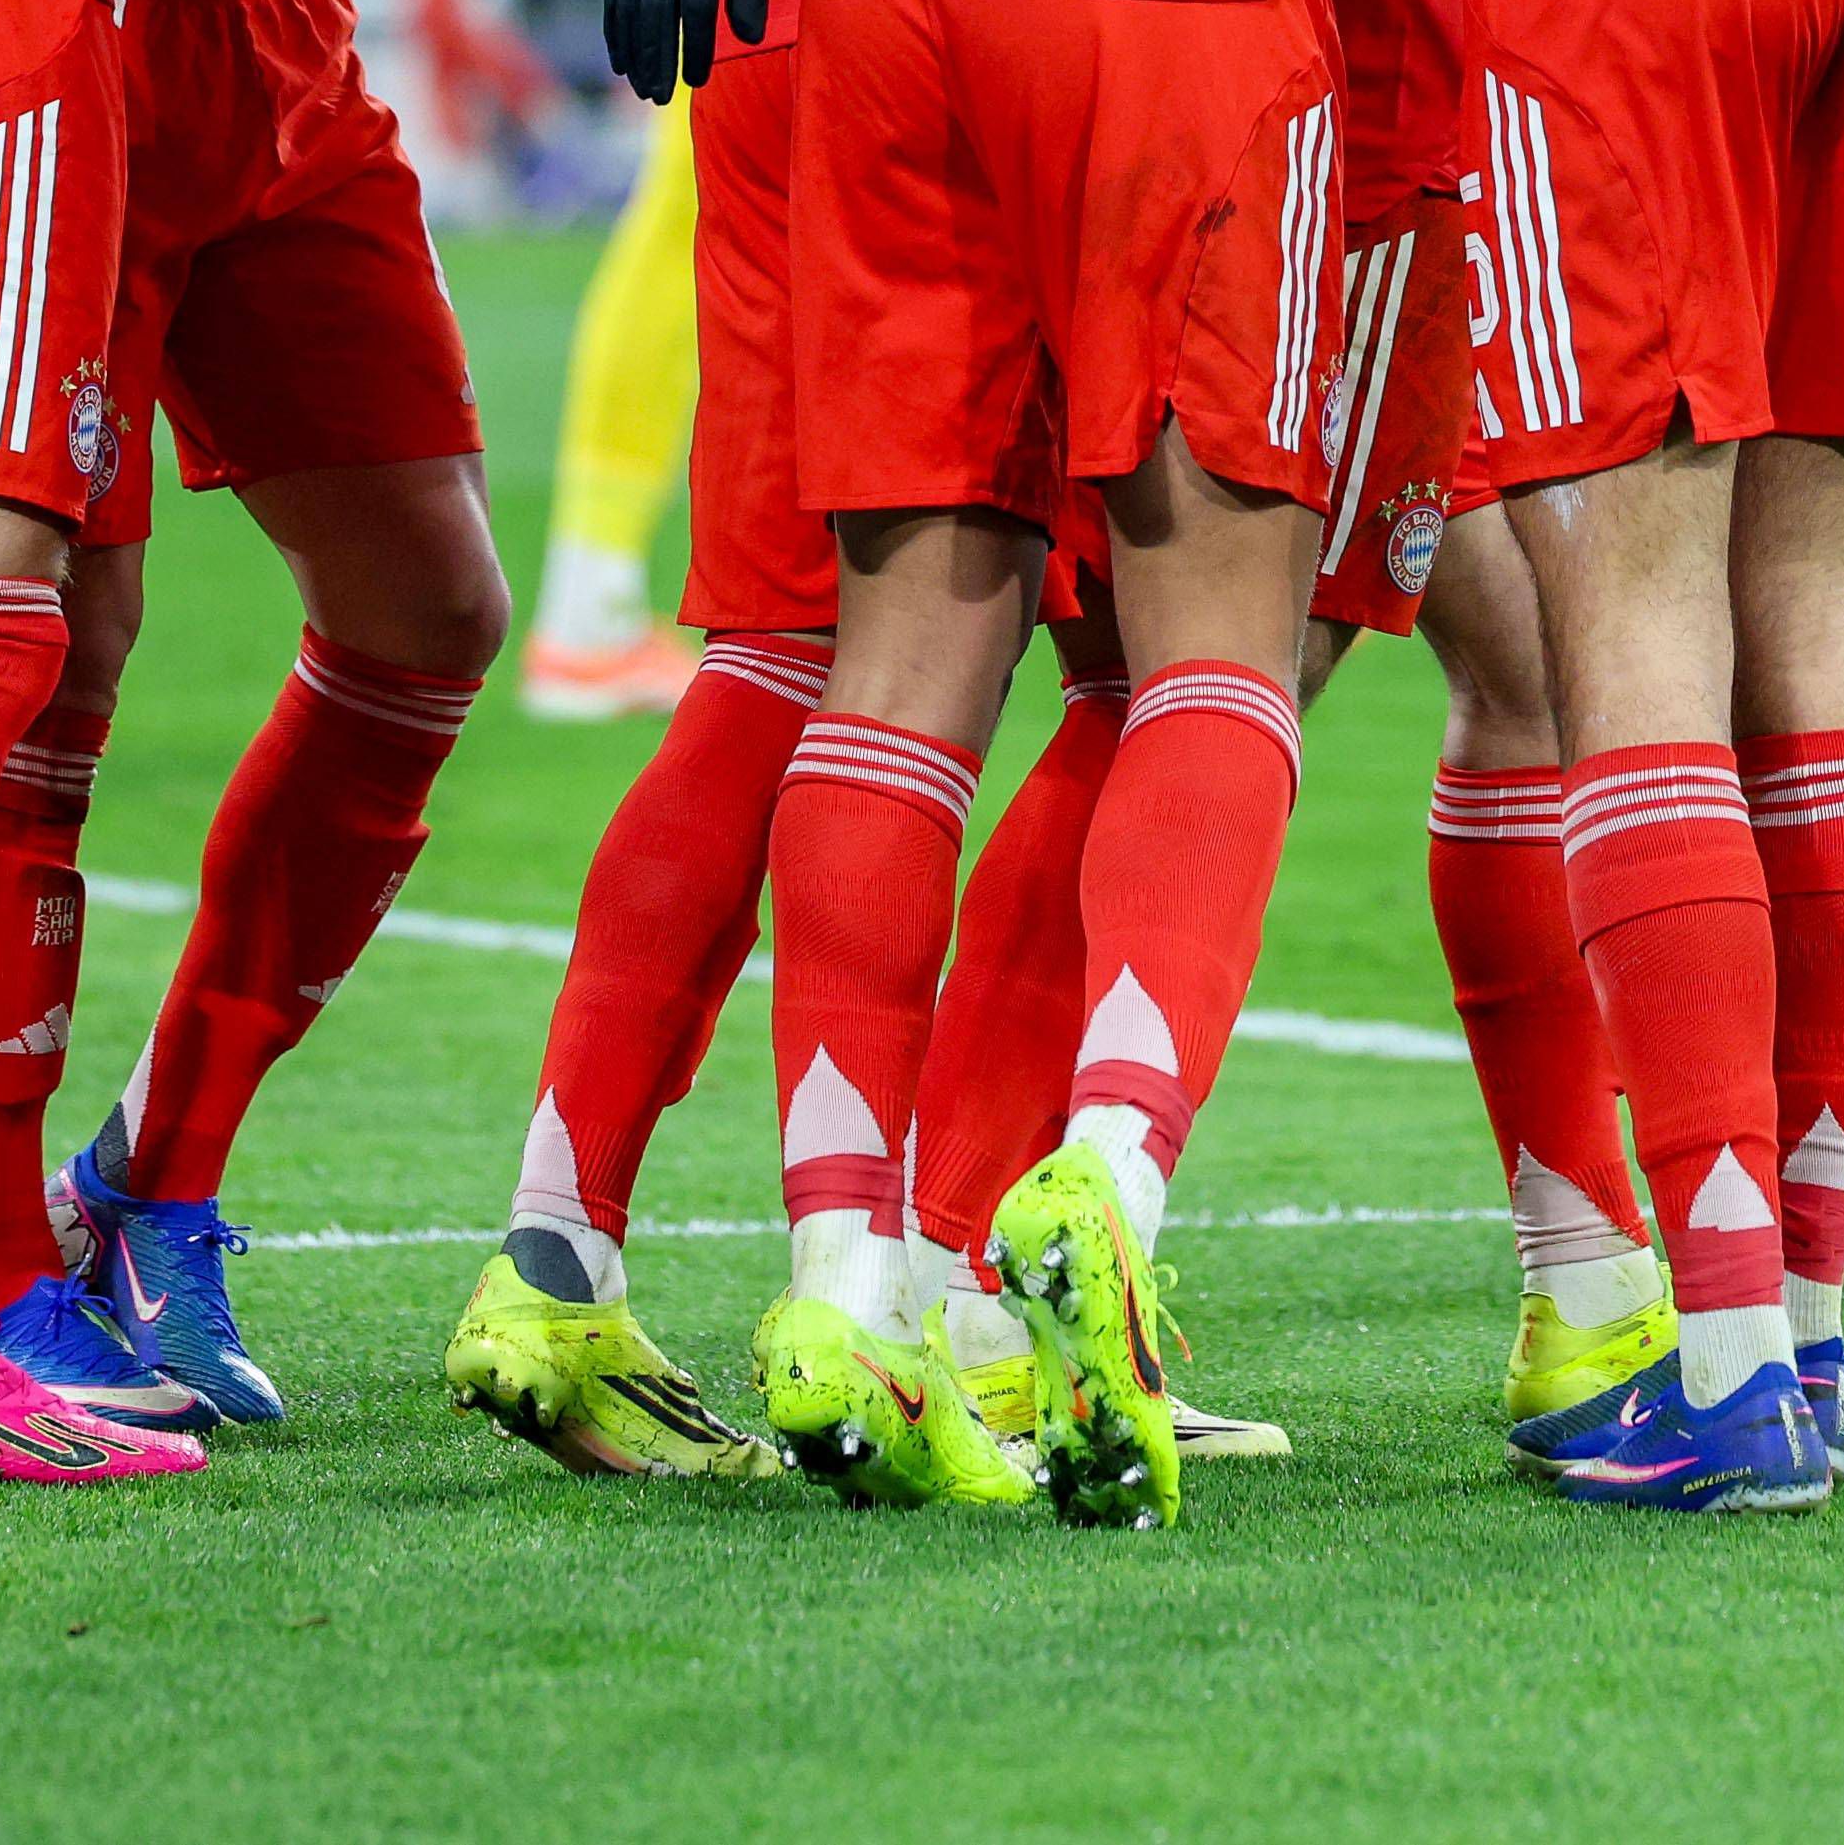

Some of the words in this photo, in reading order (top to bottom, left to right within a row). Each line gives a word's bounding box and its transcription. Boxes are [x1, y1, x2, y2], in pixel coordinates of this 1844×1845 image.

[35, 912, 74, 930] SAN
[31, 928, 75, 947] MIA
[977, 1387, 1019, 1402] RAPHAEL
